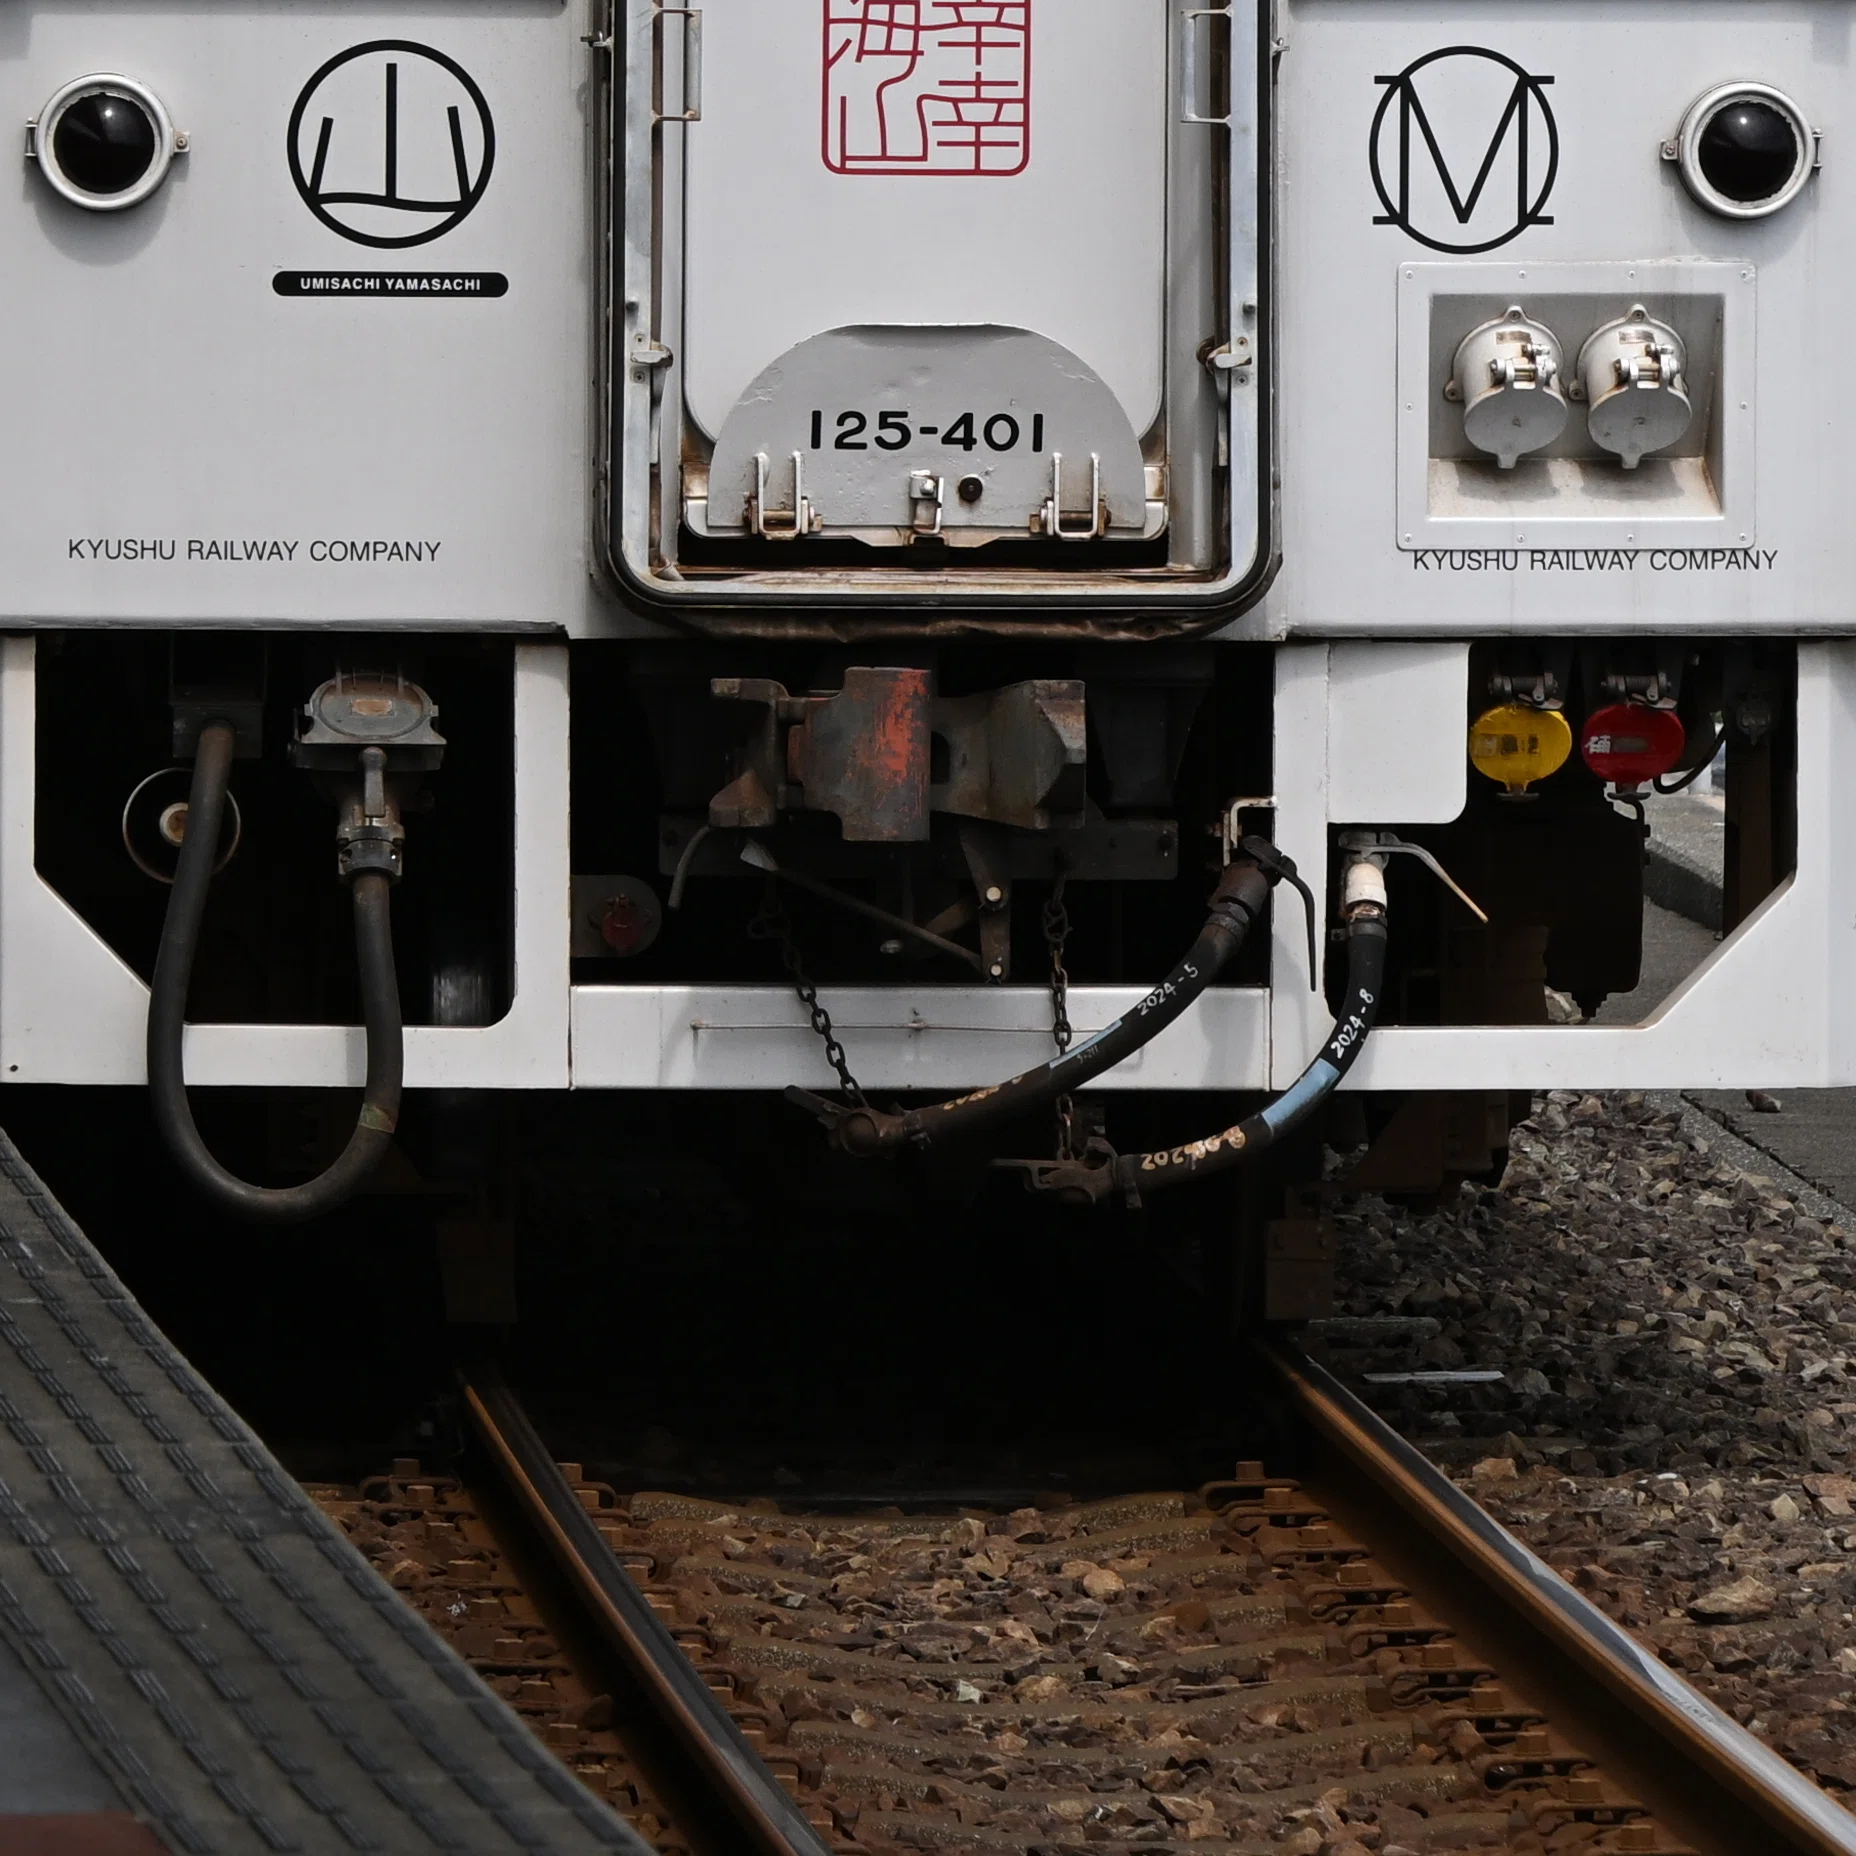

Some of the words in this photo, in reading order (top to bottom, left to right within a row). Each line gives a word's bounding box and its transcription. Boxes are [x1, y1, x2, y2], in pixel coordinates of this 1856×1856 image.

[300, 277, 381, 291] UMISACHI
[385, 278, 481, 292] YAMASACHI
[811, 409, 1044, 453] 125-401
[68, 538, 175, 560] KYUSHU
[187, 540, 299, 561] RAILWAY
[310, 540, 441, 562] COMPANY
[1413, 549, 1519, 571] KYUSHU
[1530, 549, 1640, 571] RAILWAY
[1650, 549, 1778, 571] COMPANY
